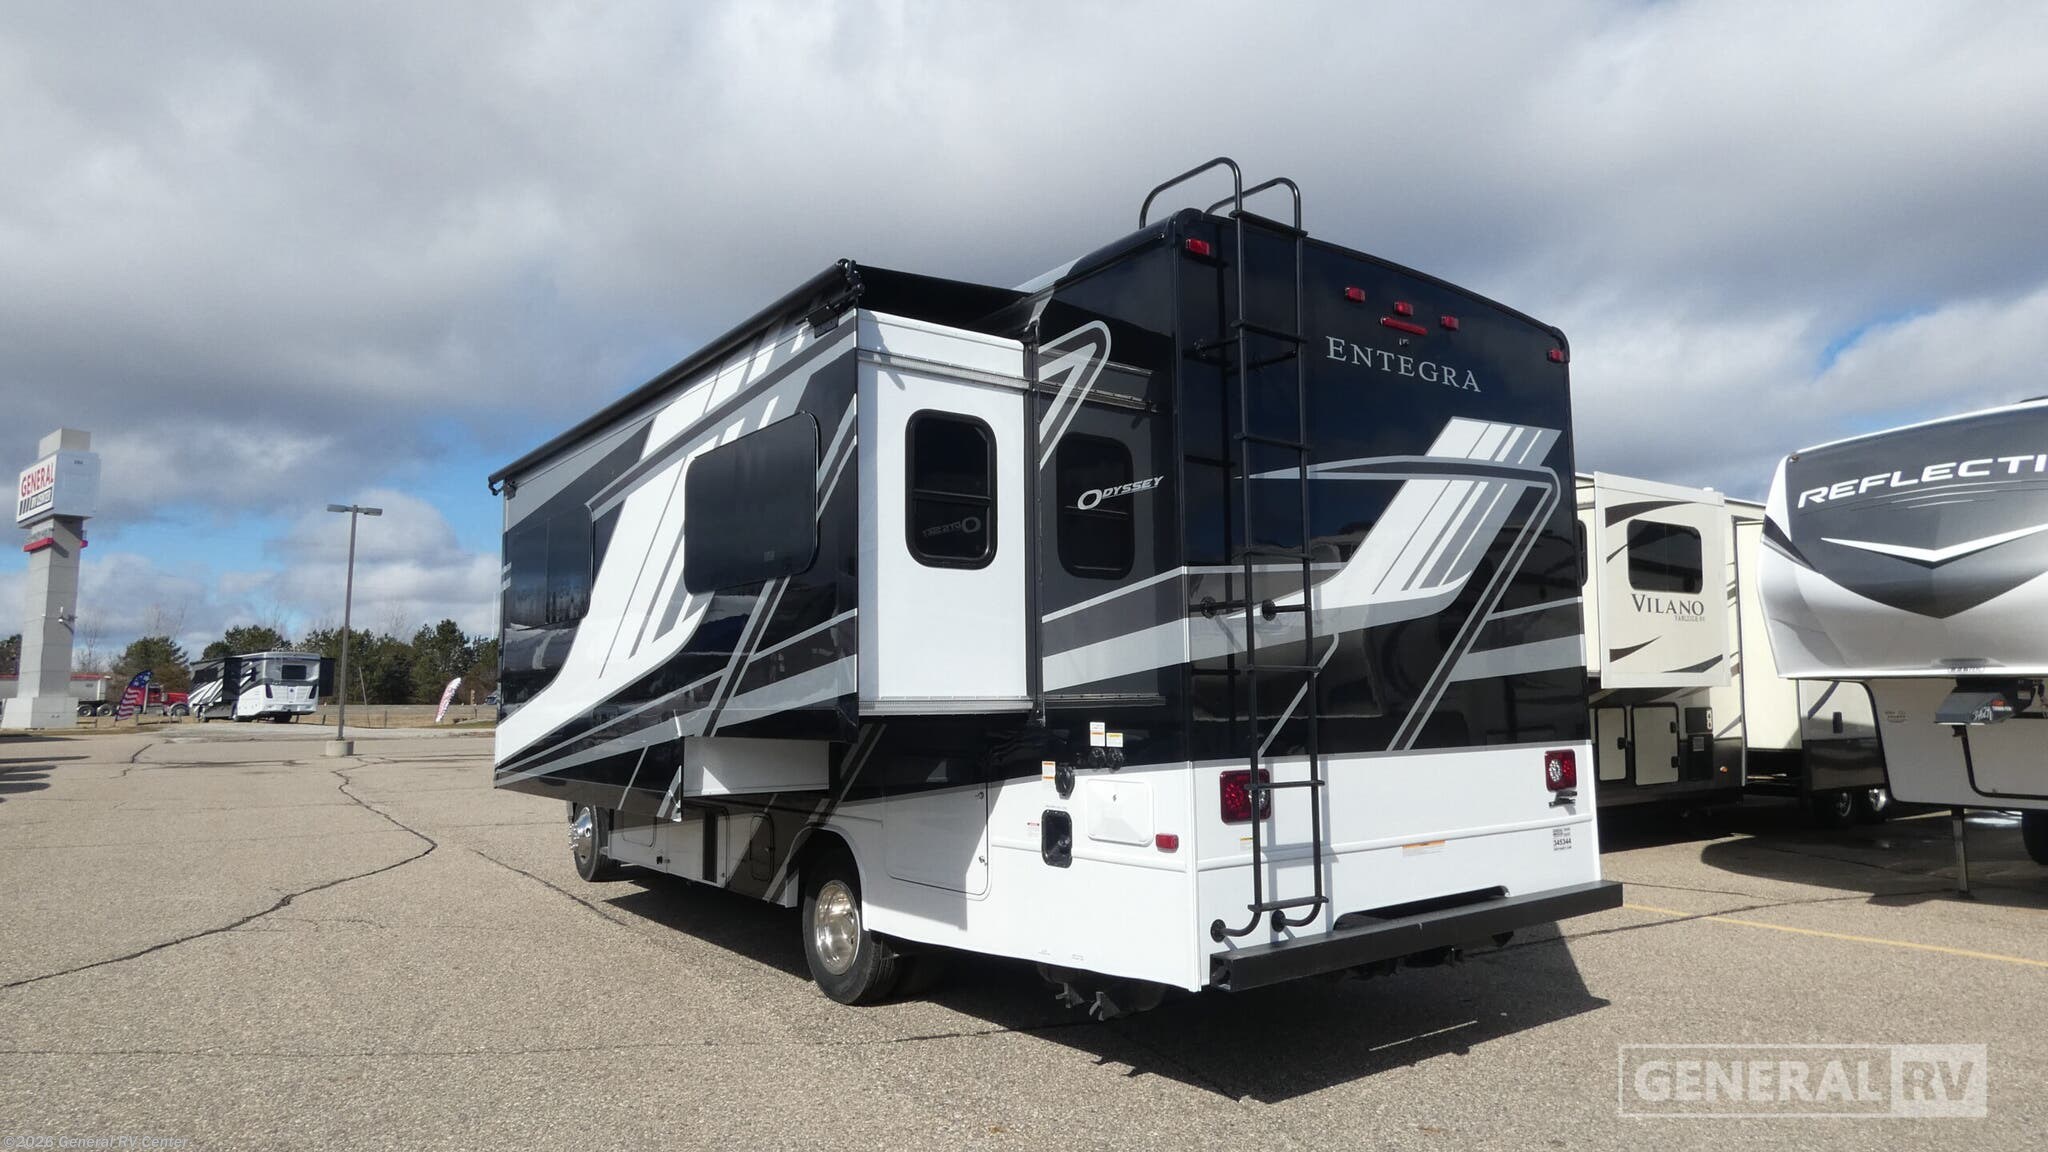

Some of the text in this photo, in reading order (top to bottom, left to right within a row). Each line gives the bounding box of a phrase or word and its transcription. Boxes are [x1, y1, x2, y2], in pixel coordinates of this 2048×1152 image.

[1325, 335, 1482, 393] ENTEGRA
[21, 463, 54, 497] GENERAL
[1077, 475, 1164, 510] ODYSSEY
[1631, 593, 1704, 616] VILANO
